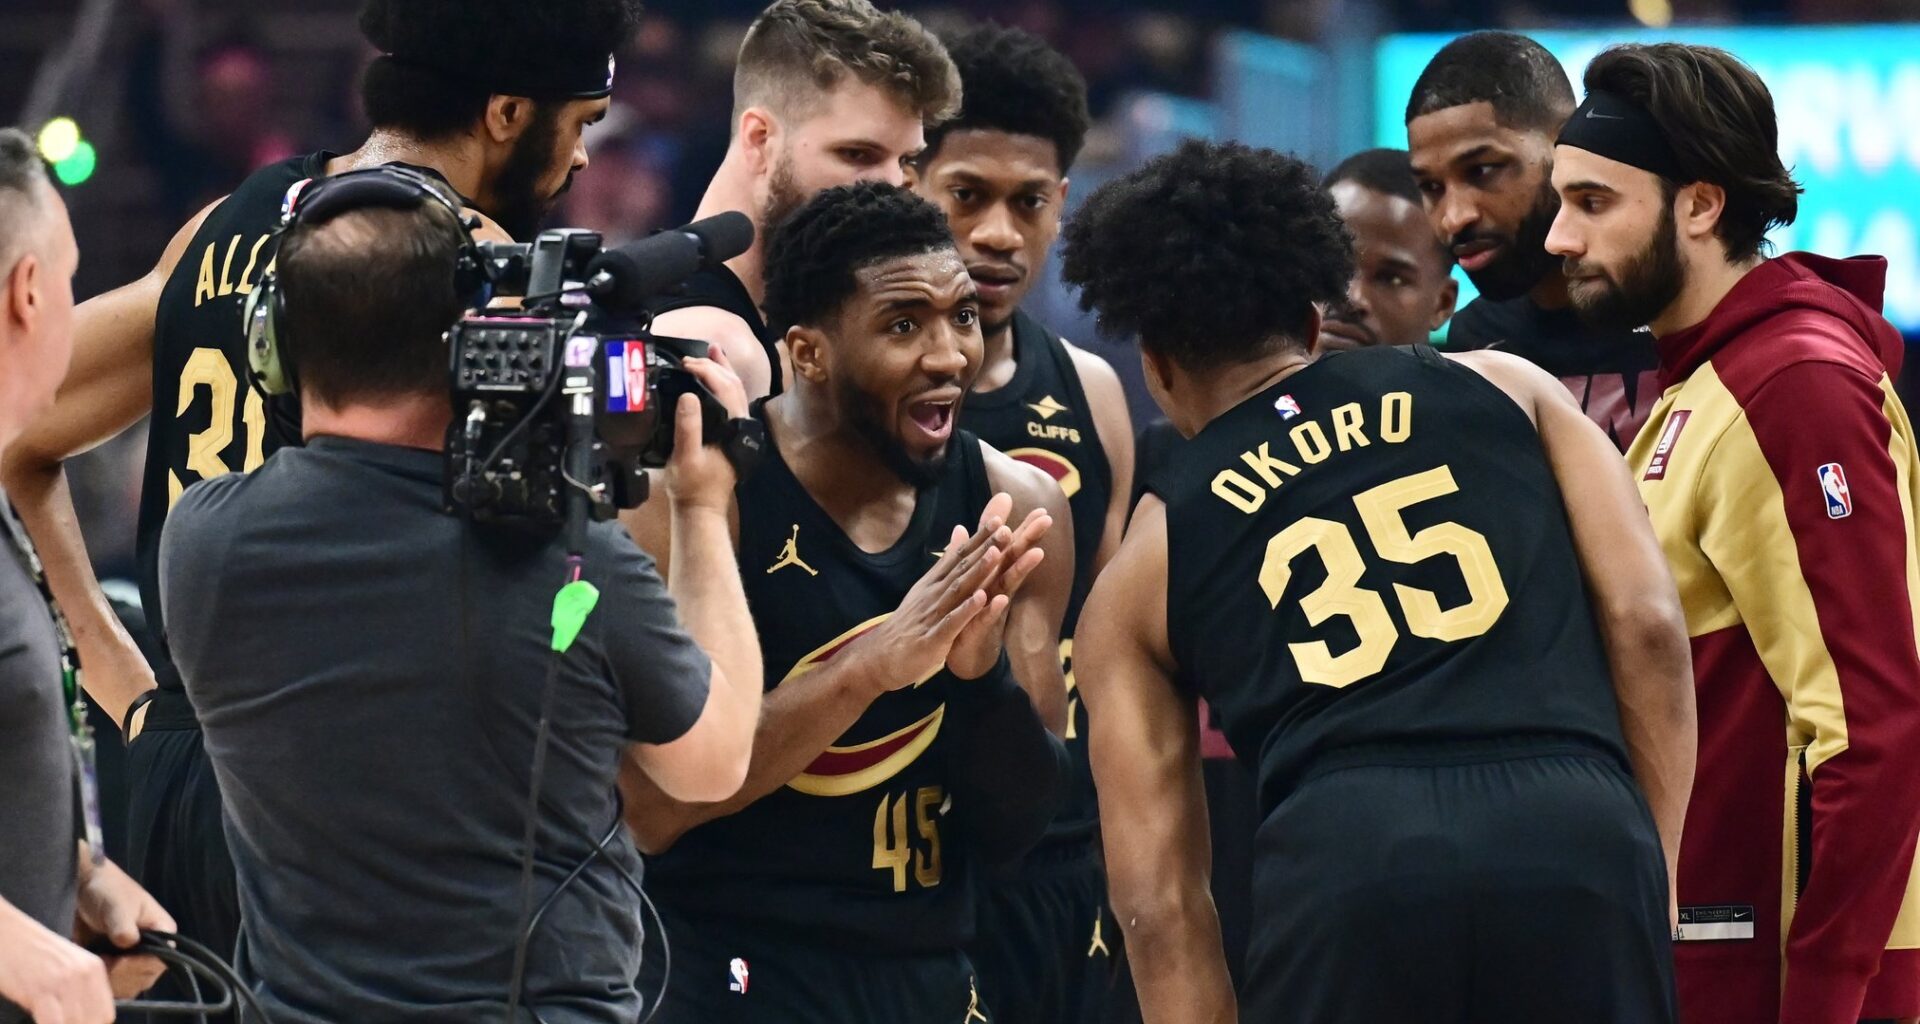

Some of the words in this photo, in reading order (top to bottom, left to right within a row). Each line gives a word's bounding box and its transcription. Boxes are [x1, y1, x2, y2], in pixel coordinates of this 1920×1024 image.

[195, 233, 278, 307] ALL
[1027, 421, 1081, 443] CLIFFS
[1210, 391, 1412, 514] OKORO
[1257, 464, 1510, 688] 35
[872, 785, 943, 892] 45
